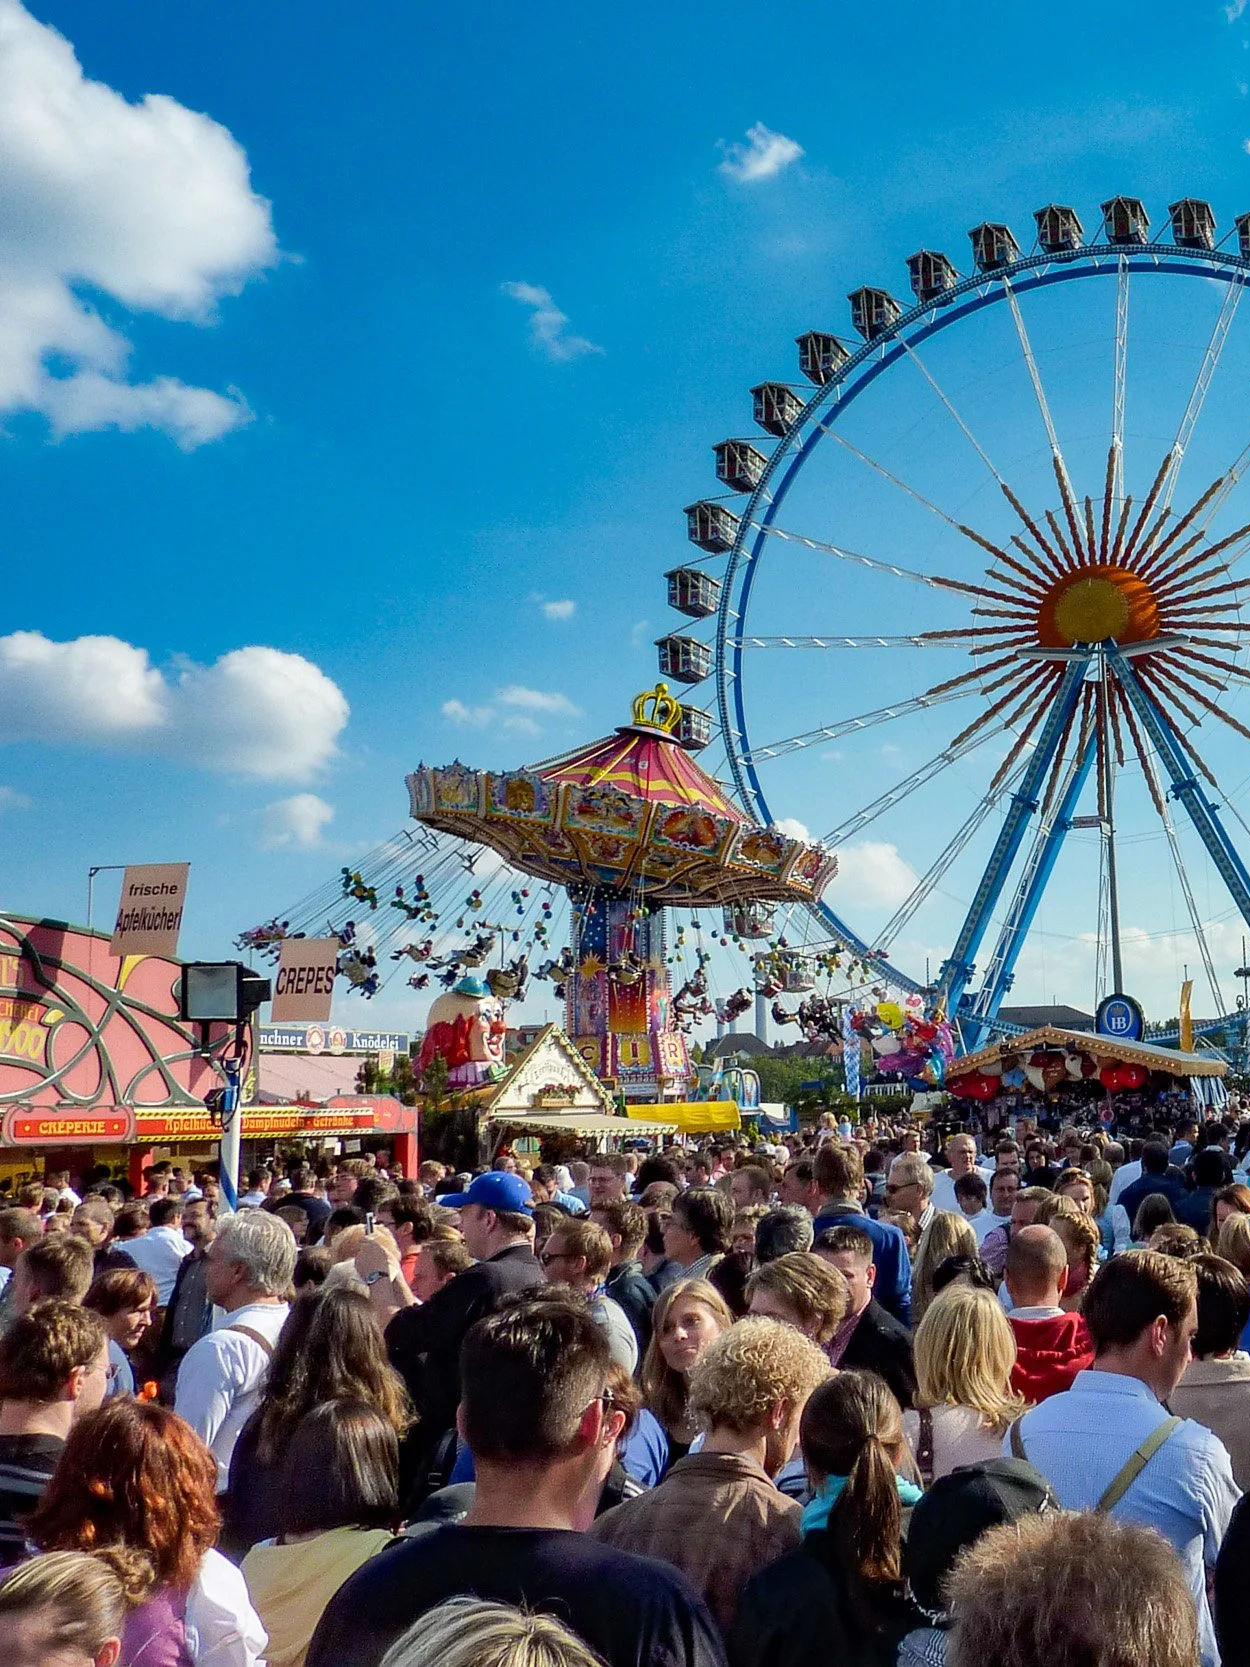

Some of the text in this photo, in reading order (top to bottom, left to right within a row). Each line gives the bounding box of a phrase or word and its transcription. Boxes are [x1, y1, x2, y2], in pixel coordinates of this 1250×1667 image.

[129, 882, 178, 897] frische
[115, 905, 184, 939] Apfelkücherl
[275, 965, 335, 996] CREPES
[1111, 1016, 1127, 1030] HB
[260, 1029, 399, 1051] nchner Knödelei
